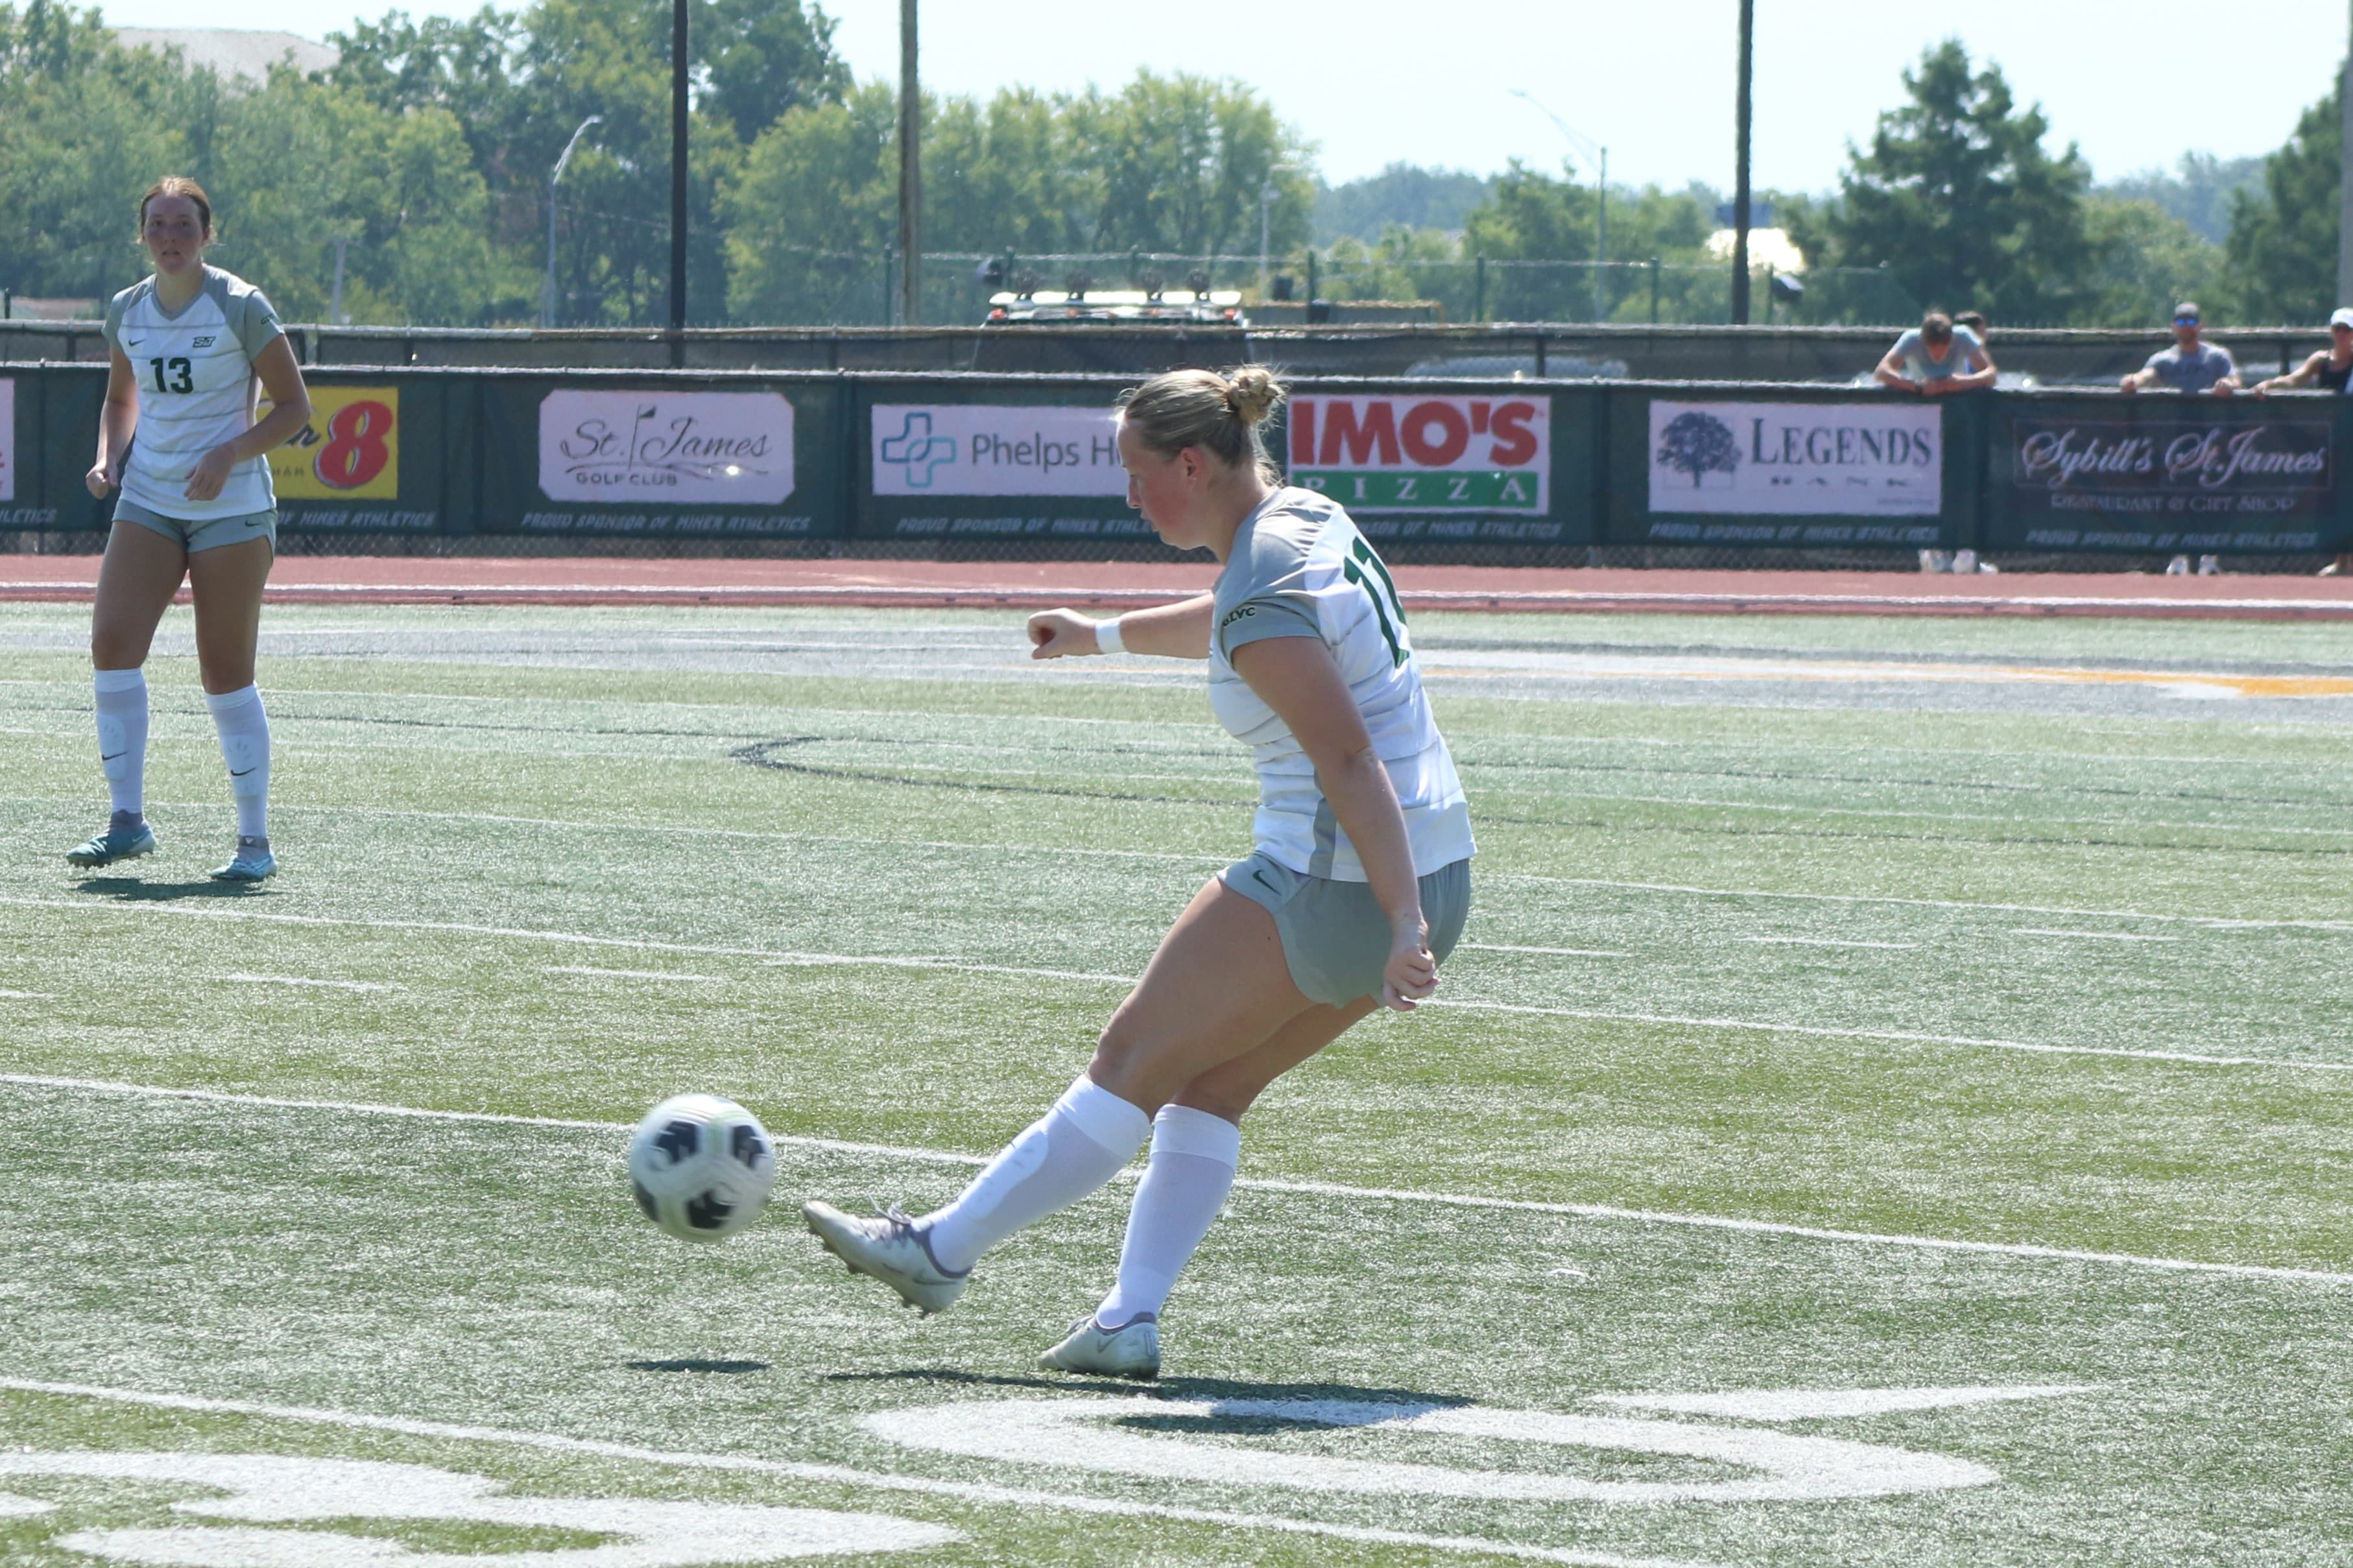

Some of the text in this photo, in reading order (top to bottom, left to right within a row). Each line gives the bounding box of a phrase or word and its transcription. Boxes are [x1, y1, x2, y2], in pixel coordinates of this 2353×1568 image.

[150, 357, 194, 394] 13
[313, 399, 394, 491] 8
[560, 415, 772, 464] St. James
[972, 432, 1081, 473] Phelps
[1291, 400, 1538, 468] IMO'S
[576, 472, 678, 486] GOLF CLUB
[2022, 426, 2155, 490] Sybill's
[1302, 476, 1527, 502] PIZZA
